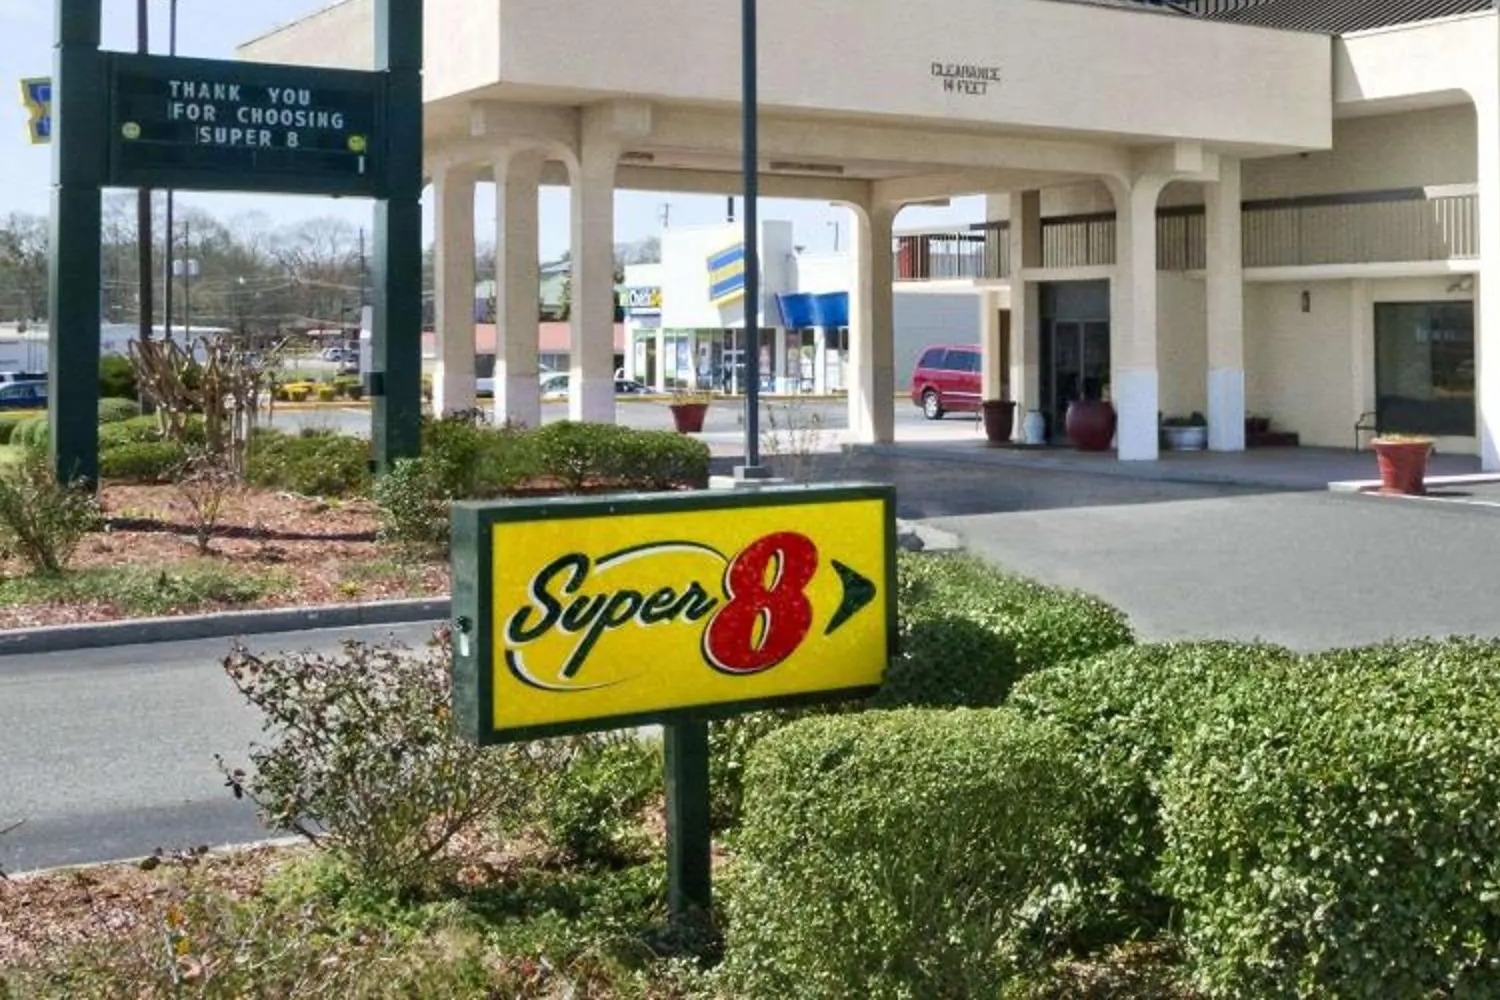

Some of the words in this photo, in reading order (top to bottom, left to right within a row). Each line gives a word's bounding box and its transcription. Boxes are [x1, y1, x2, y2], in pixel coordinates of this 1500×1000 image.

[169, 80, 240, 101] THANK
[268, 87, 311, 105] YOU
[172, 103, 216, 121] FOR
[237, 106, 344, 129] CHOOSING
[199, 126, 272, 147] SUPER
[286, 131, 299, 148] 8
[505, 551, 720, 680] Super
[702, 531, 819, 675] 8
